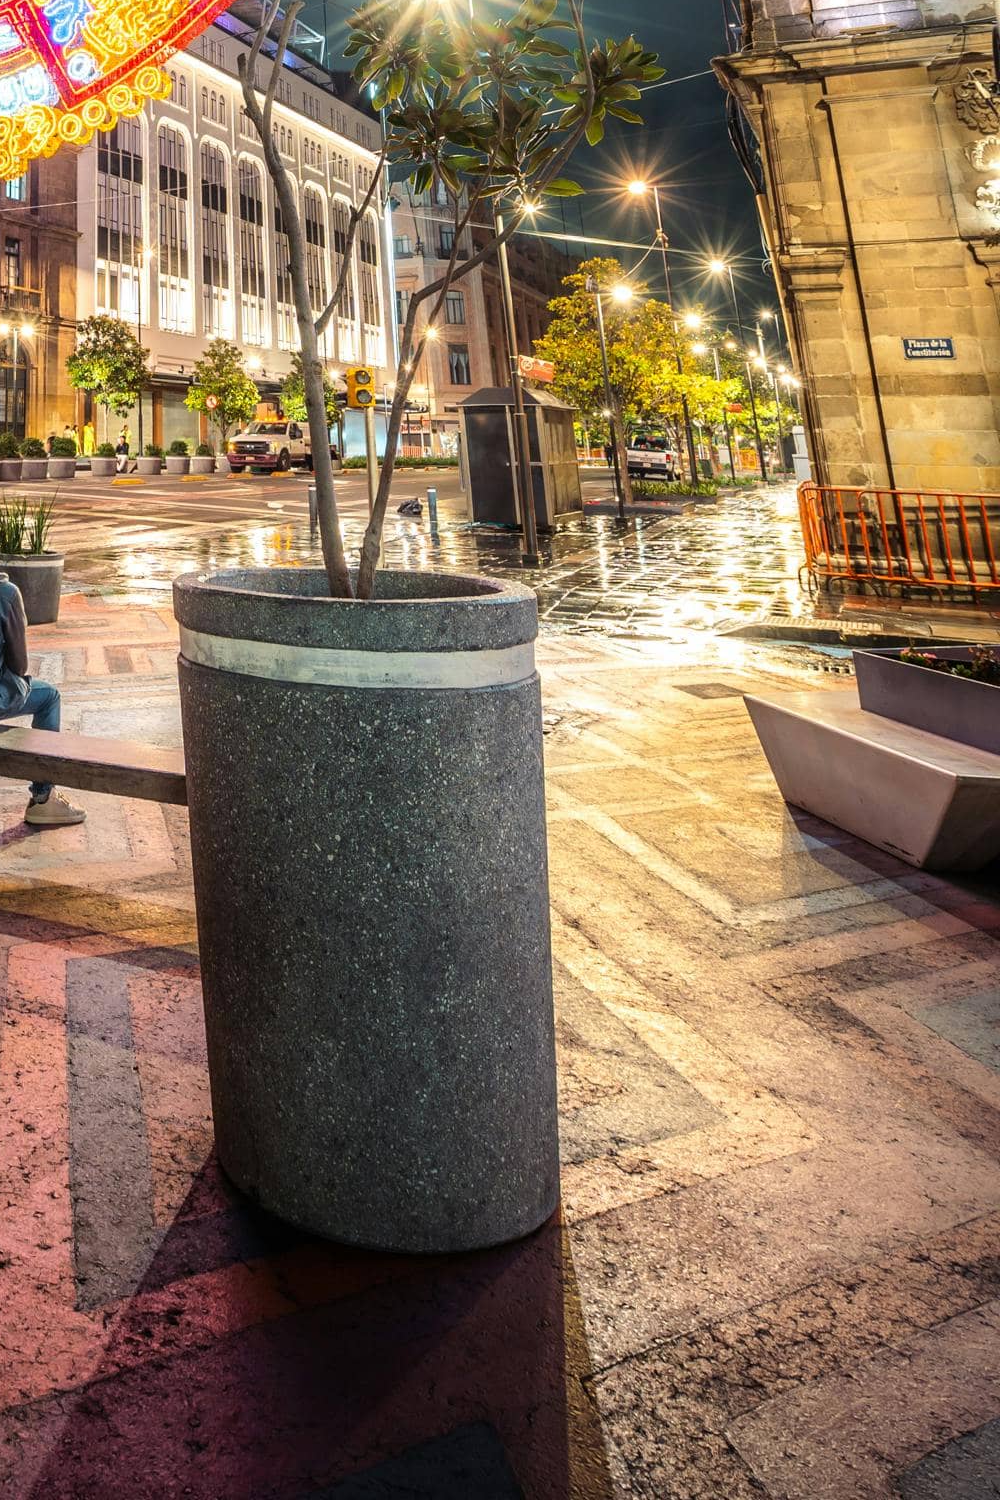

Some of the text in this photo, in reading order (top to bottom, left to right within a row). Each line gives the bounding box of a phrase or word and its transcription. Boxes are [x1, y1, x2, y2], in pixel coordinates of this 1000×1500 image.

[908, 339, 947, 348] Plaza de la
[907, 348, 951, 357] Constitución
